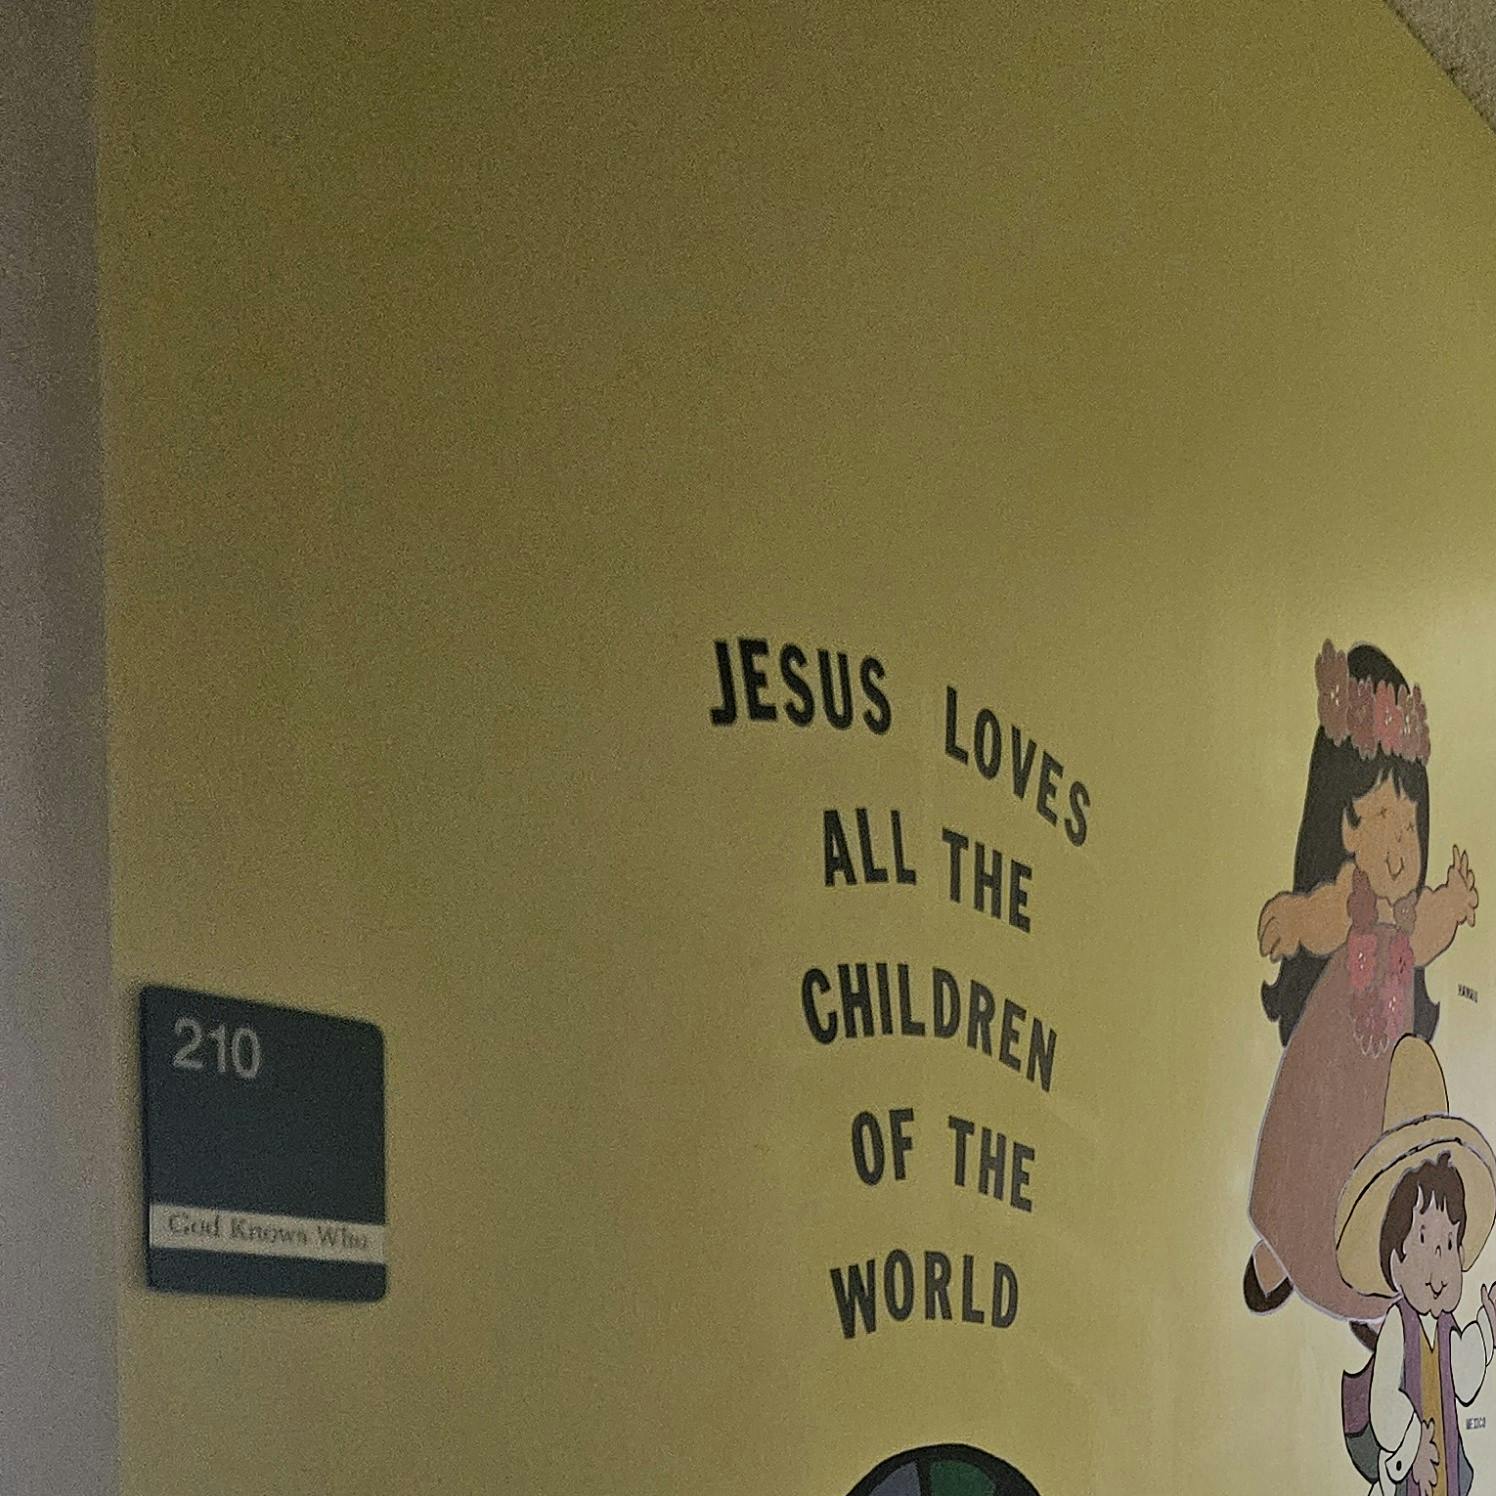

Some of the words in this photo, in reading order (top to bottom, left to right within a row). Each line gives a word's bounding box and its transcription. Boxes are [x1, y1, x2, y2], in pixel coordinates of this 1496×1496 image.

[710, 638, 891, 735] JESUS
[945, 685, 1091, 847] LOVES
[824, 808, 917, 887] ALL
[942, 827, 1032, 933] THE
[172, 1016, 262, 1080] 210
[802, 962, 1057, 1093] CHILDREN
[851, 1108, 914, 1187] OF
[948, 1115, 1035, 1213] THE
[169, 1211, 219, 1239] God
[830, 1249, 1019, 1339] WORLD
